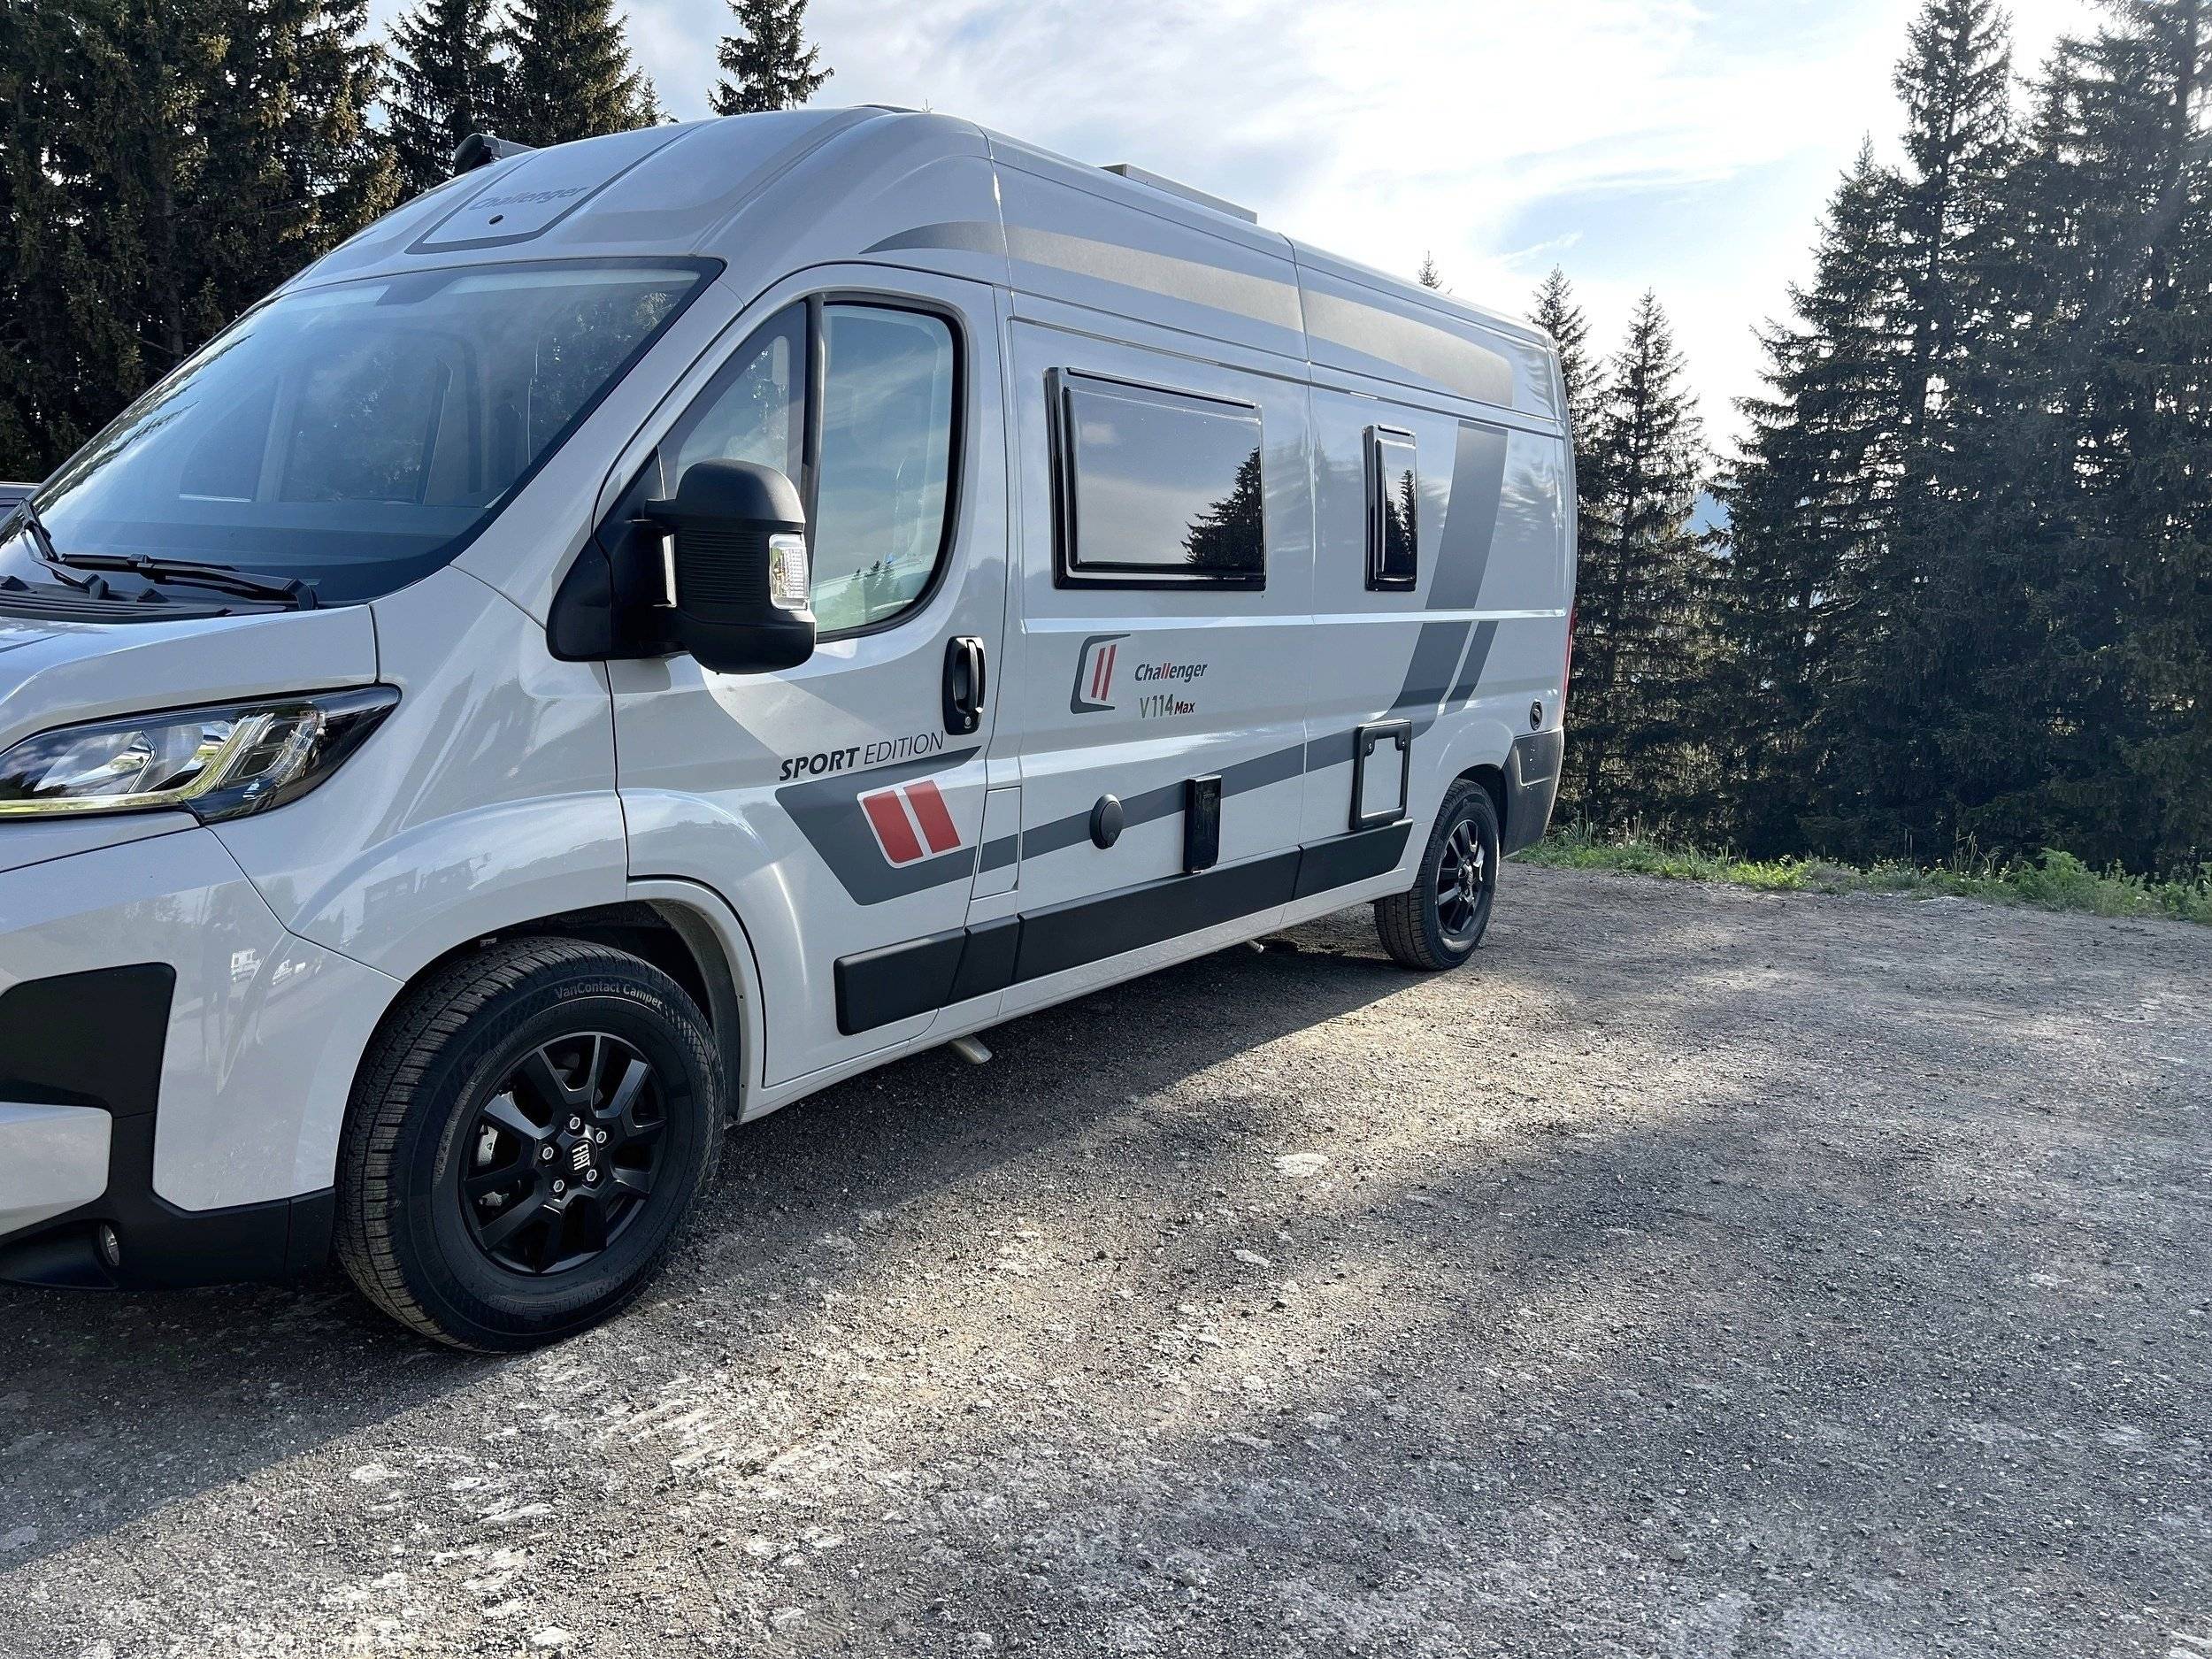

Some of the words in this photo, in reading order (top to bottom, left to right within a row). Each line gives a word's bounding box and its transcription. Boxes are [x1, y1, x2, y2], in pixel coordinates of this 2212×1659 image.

[468, 186, 590, 211] Challenger
[1134, 663, 1209, 683] Challenger
[779, 746, 861, 782] SPORT
[864, 730, 944, 765] EDITION
[554, 981, 620, 1000] VanContact
[622, 983, 664, 1011] Camper
[572, 1143, 591, 1171] FIAT
